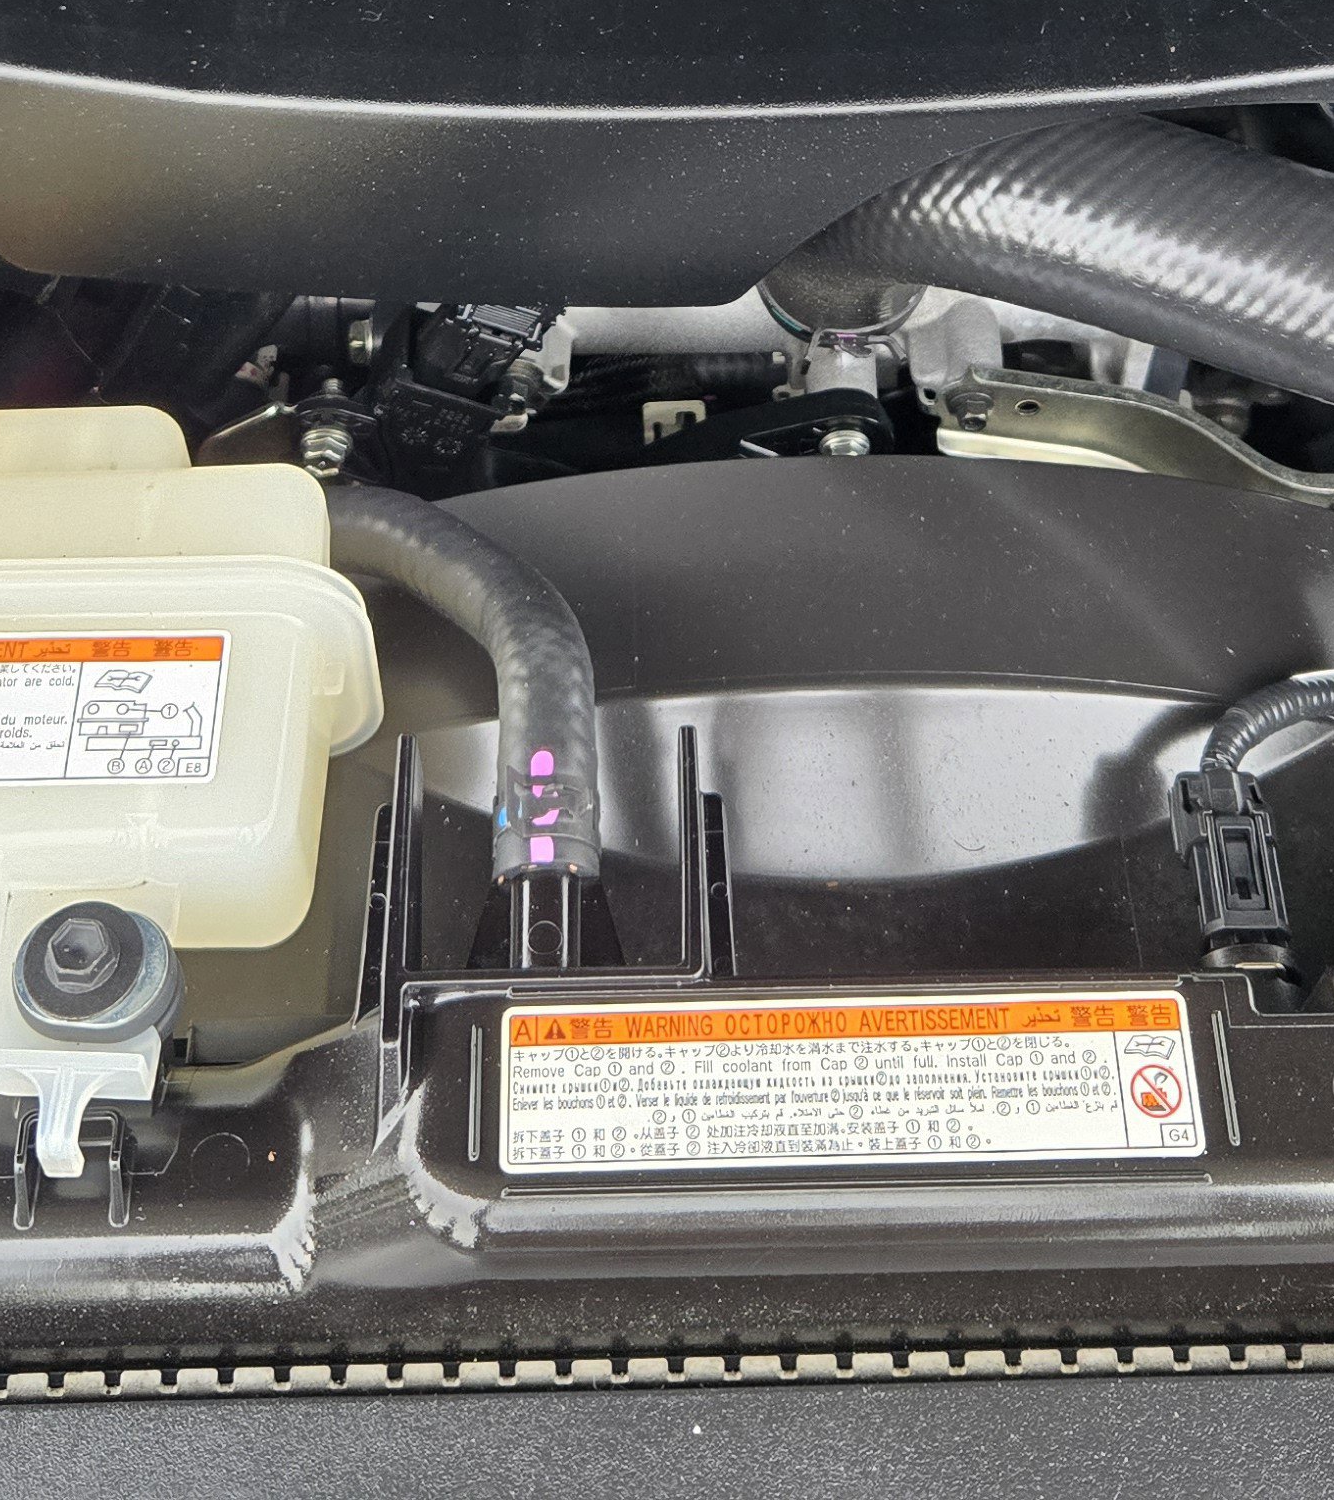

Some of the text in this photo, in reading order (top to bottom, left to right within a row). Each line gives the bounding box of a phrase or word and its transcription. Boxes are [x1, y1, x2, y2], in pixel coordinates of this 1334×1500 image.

[92, 640, 130, 658] 警告
[153, 639, 193, 658] 警告
[24, 677, 43, 687] are
[48, 675, 75, 687] cold.
[185, 762, 202, 774] E8
[513, 1019, 532, 1043] A
[569, 1017, 613, 1040] 警告
[625, 1014, 713, 1039] WARNING
[724, 1011, 847, 1036] ОСТОРОЖНО
[858, 1007, 1010, 1033] AVERTISSEMENT
[1070, 1004, 1115, 1028] 警告
[1126, 1003, 1177, 1027] 警告
[512, 1065, 565, 1079] Remove
[574, 1063, 601, 1078] Cap
[628, 1061, 654, 1076] and
[694, 1059, 713, 1074] Fill
[722, 1058, 773, 1073] coolant
[782, 1058, 811, 1072] from
[820, 1056, 848, 1072] Cap
[874, 1055, 904, 1070] until
[913, 1054, 938, 1069] full.
[946, 1053, 987, 1068] Install
[995, 1052, 1023, 1068] Cap
[1050, 1050, 1077, 1065] and
[1168, 1128, 1189, 1142] G4
